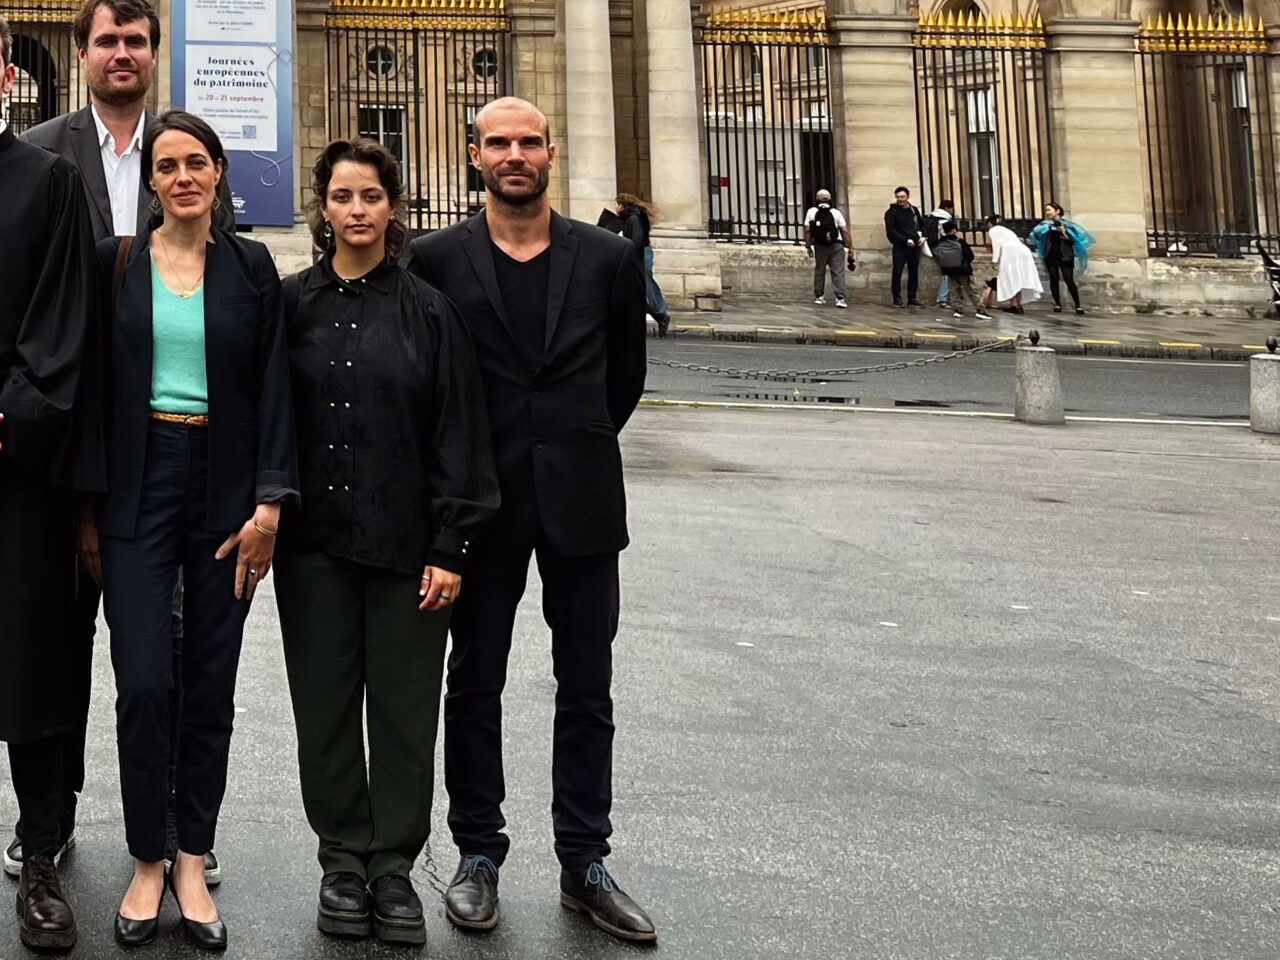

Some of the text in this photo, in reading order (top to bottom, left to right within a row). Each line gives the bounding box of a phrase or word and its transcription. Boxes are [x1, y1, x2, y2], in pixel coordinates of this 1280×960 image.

[208, 56, 255, 66] Journées
[197, 67, 265, 77] européennes
[193, 78, 268, 88] du patrimoine
